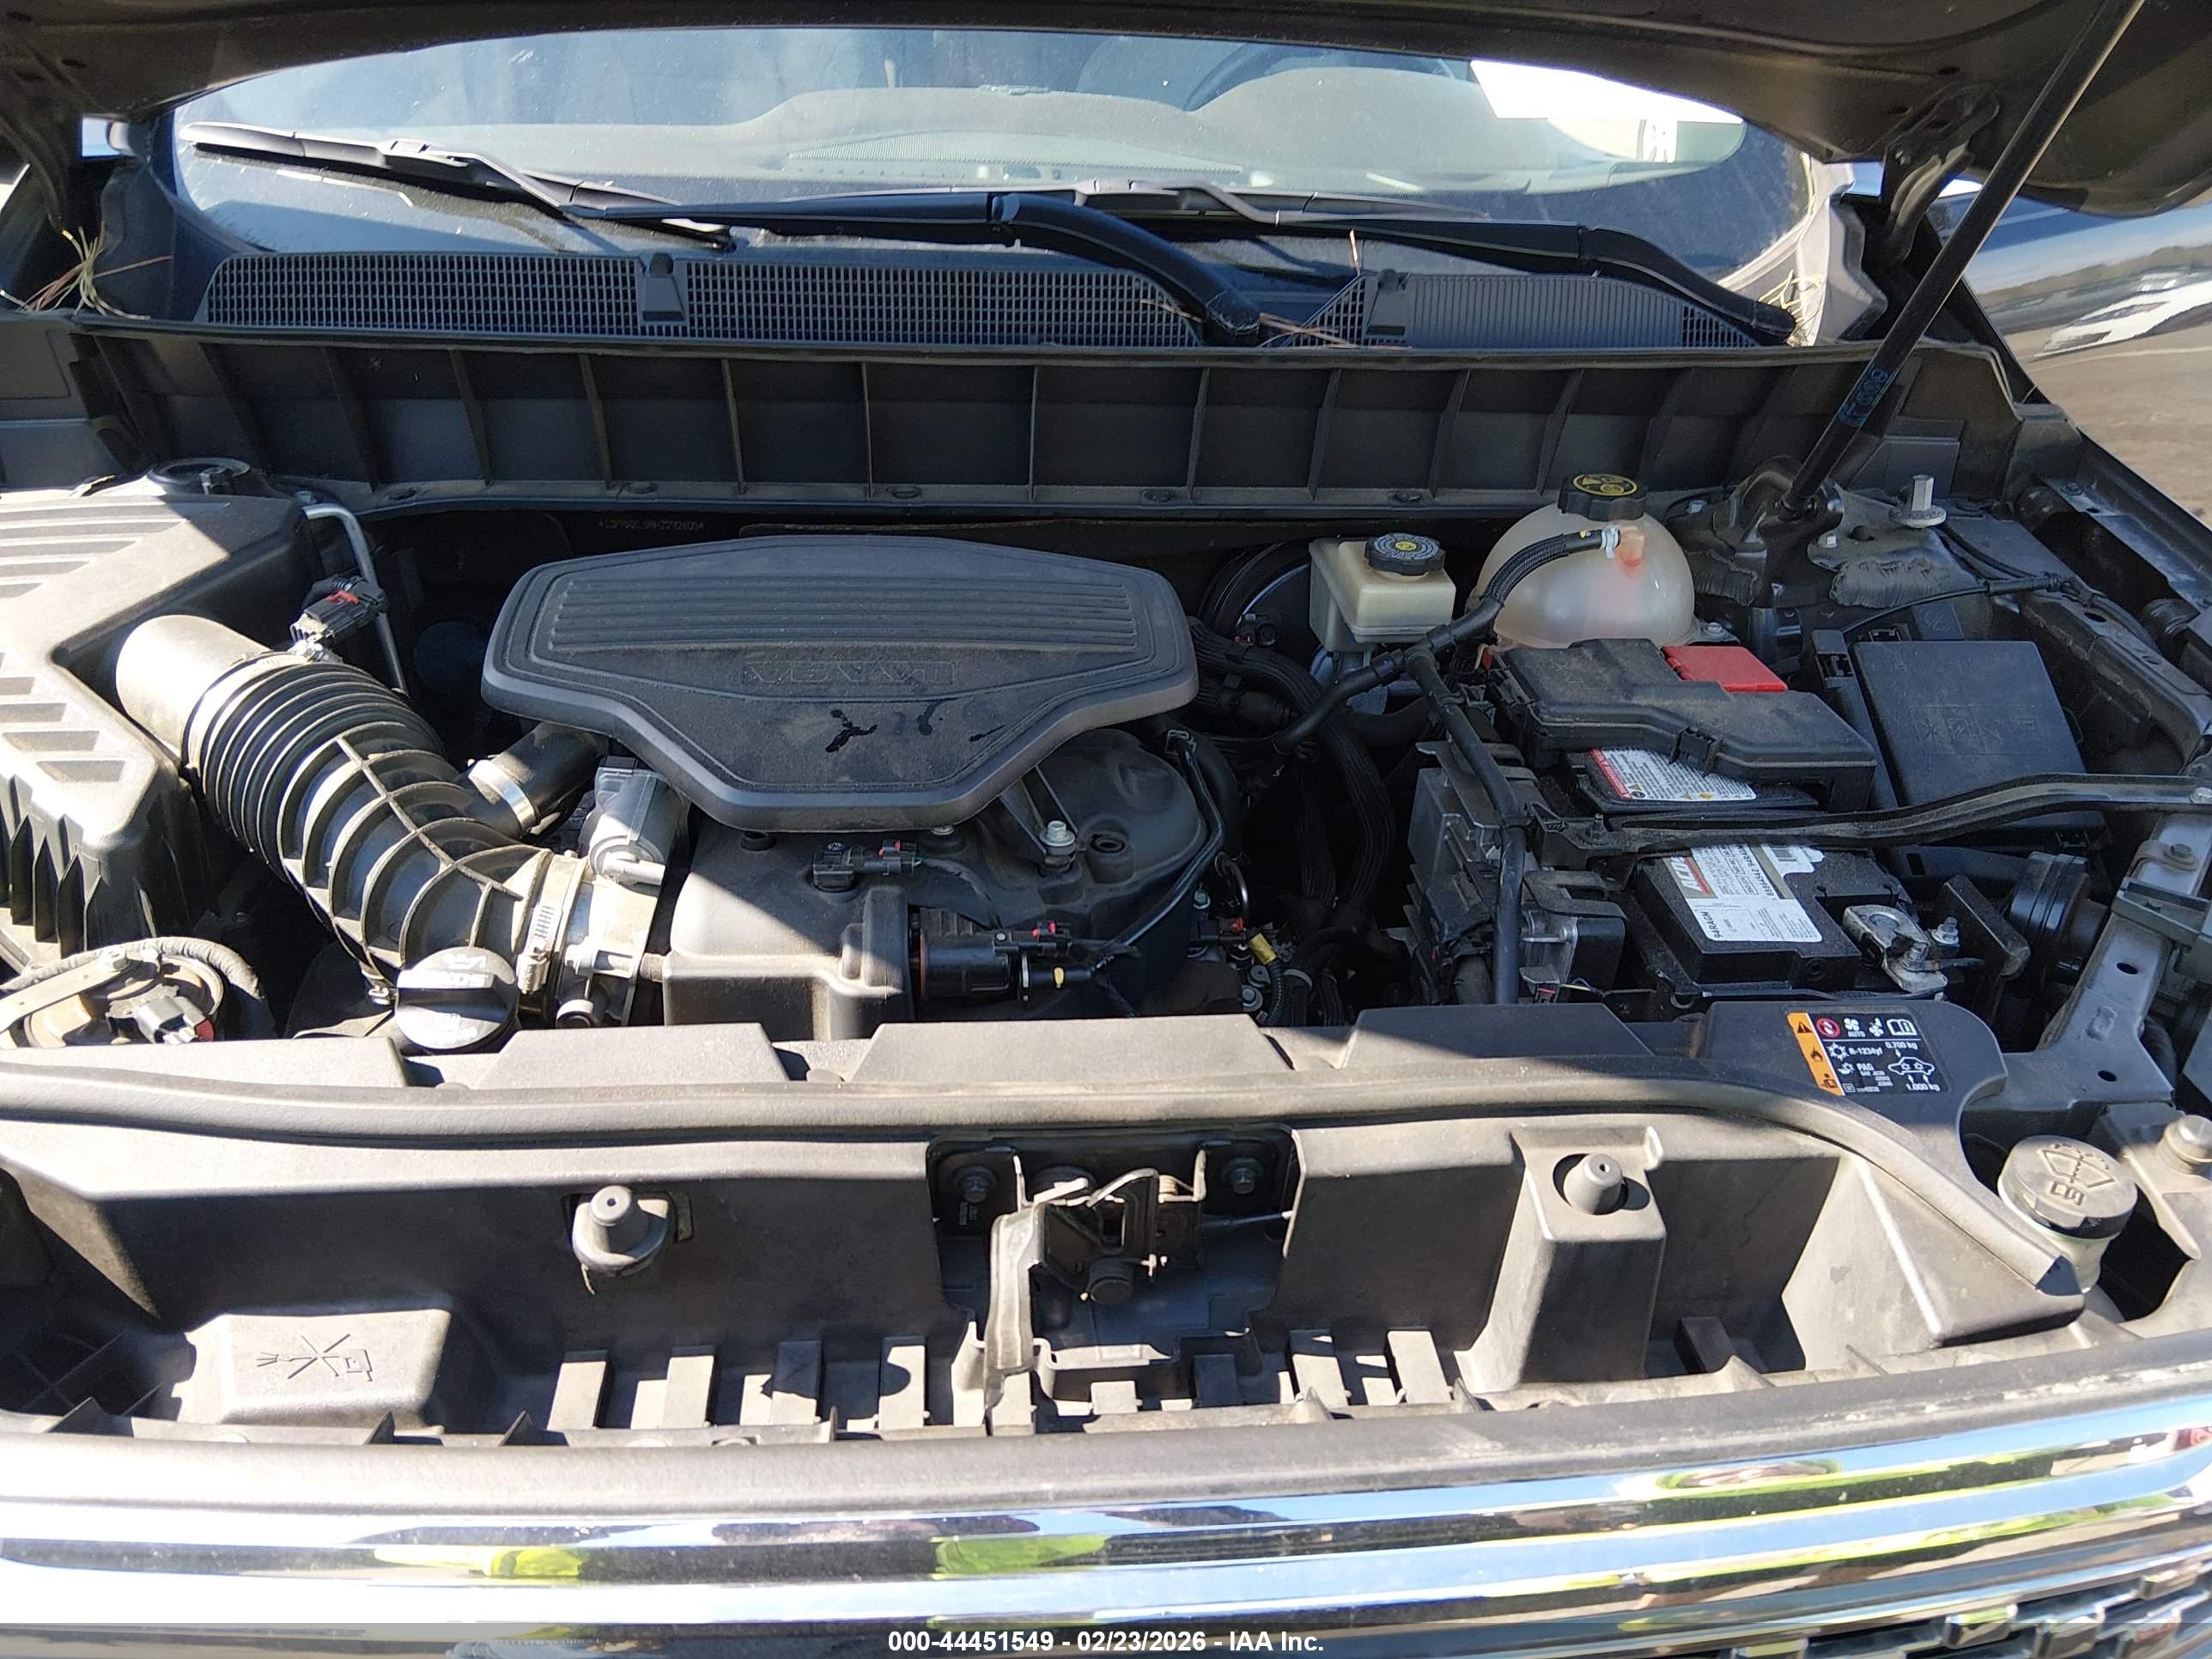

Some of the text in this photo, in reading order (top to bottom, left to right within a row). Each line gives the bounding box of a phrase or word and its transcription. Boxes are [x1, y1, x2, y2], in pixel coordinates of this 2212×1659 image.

[1701, 911, 1723, 939] 94RAGM
[1906, 1042, 1918, 1050] kg
[1848, 1047, 1883, 1055] R-1234yf
[1929, 1083, 1941, 1091] kg
